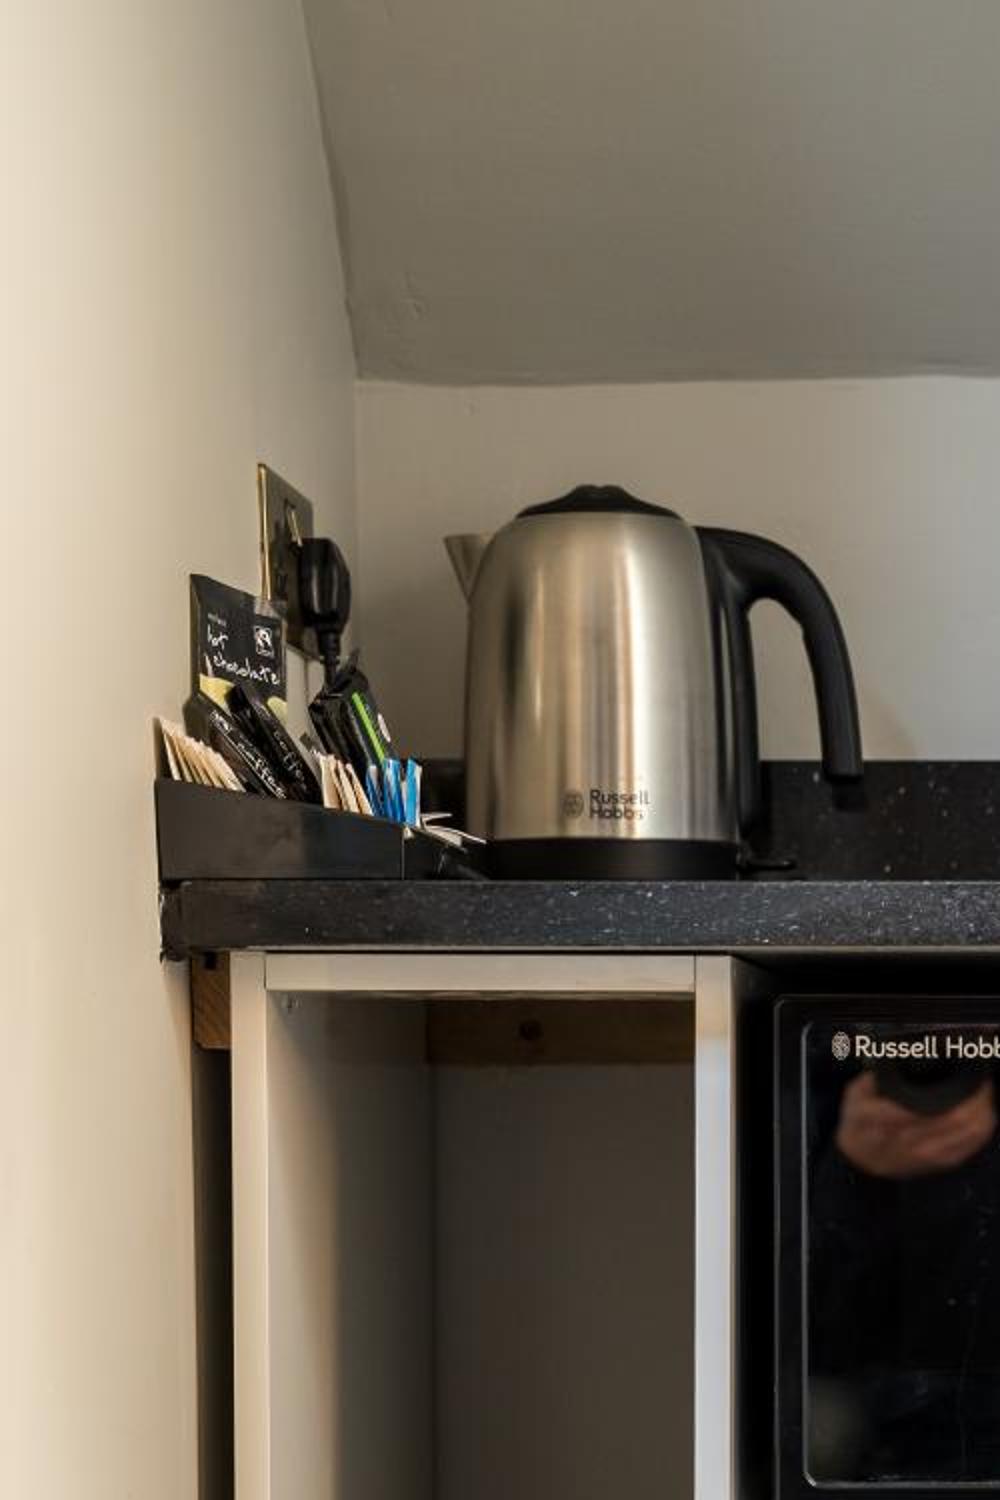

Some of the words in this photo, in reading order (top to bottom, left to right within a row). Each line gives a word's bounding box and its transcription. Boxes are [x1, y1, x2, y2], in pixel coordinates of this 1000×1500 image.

[590, 789, 650, 805] Russell
[590, 805, 644, 820] Hobbs
[855, 1035, 939, 1058] Russell
